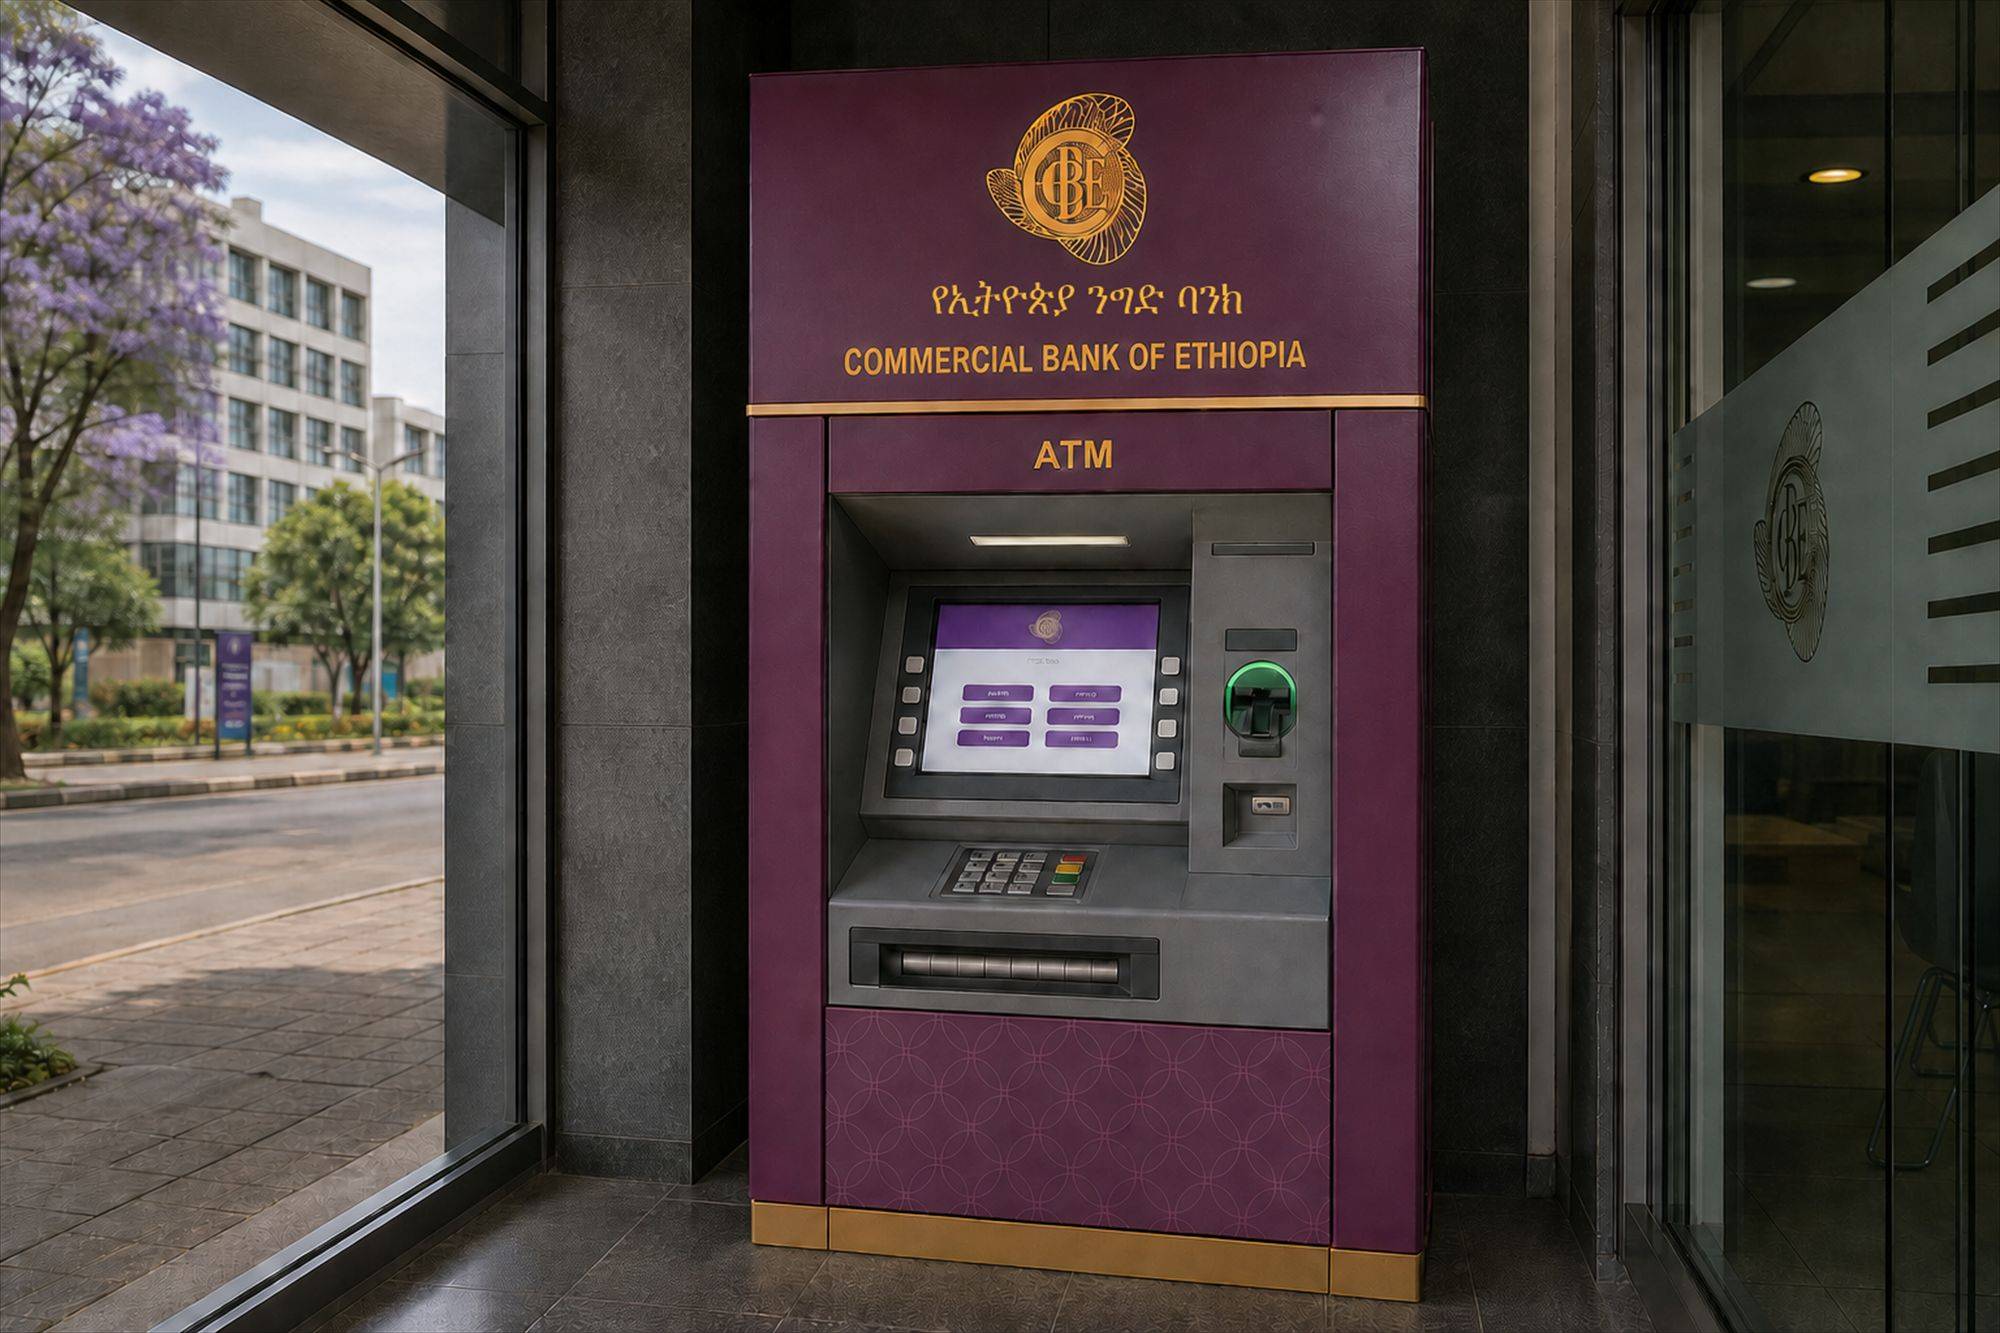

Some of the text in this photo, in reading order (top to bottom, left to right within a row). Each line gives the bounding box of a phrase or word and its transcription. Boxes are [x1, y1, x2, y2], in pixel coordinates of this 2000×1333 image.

[1023, 129, 1110, 234] CBE
[932, 280, 1243, 318] የኢትዮጵያ ንግድ ባንክ
[844, 340, 1306, 376] COMMERCIAL BANK OF ETHIOPIA
[1034, 439, 1113, 469] ATM
